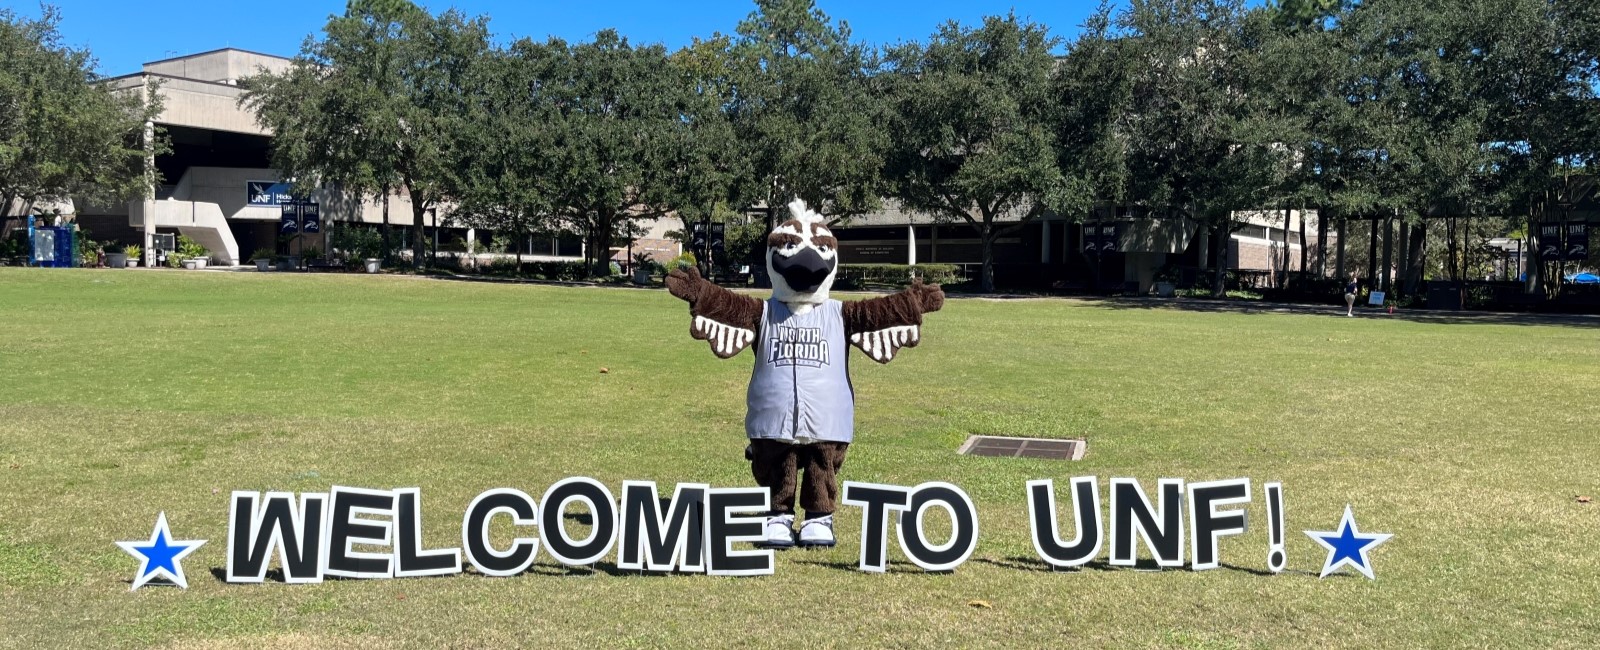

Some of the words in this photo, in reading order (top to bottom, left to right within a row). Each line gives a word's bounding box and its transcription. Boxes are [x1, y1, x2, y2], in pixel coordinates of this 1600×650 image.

[251, 194, 271, 203] UNF
[1542, 226, 1558, 235] UNF
[1569, 224, 1586, 234] UNF
[779, 326, 821, 343] NORTH
[768, 338, 830, 365] FLORIDA
[226, 476, 774, 584] WELCOME
[842, 481, 979, 572] TO
